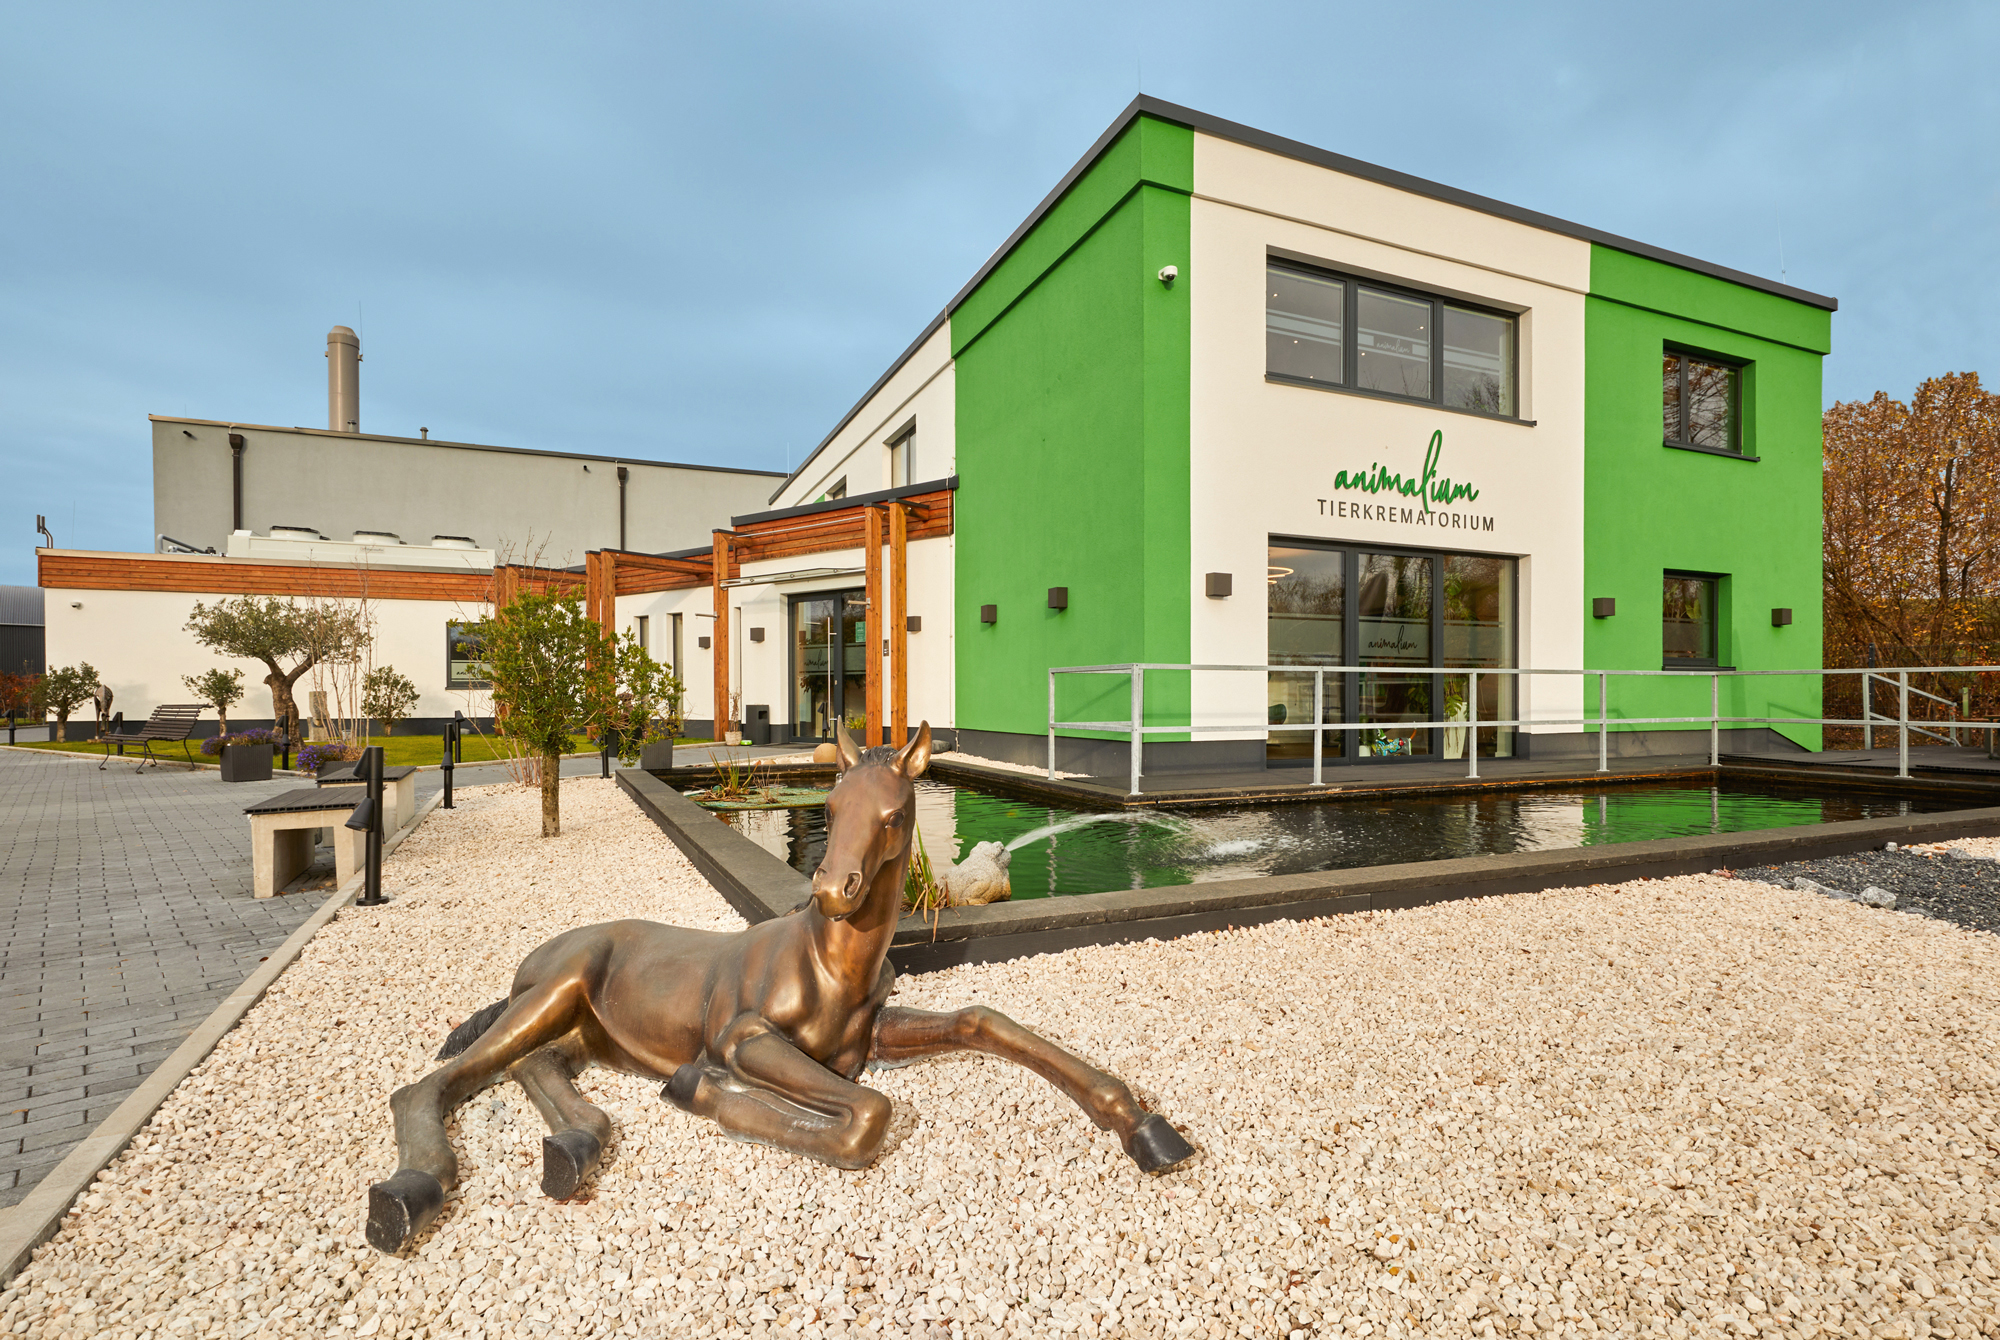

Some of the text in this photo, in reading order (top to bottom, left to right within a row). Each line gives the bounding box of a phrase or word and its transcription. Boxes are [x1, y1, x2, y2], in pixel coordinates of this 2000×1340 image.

[1334, 429, 1480, 514] animalium
[1317, 498, 1495, 532] TIERKREMATORIUM
[1368, 624, 1418, 654] animalium
